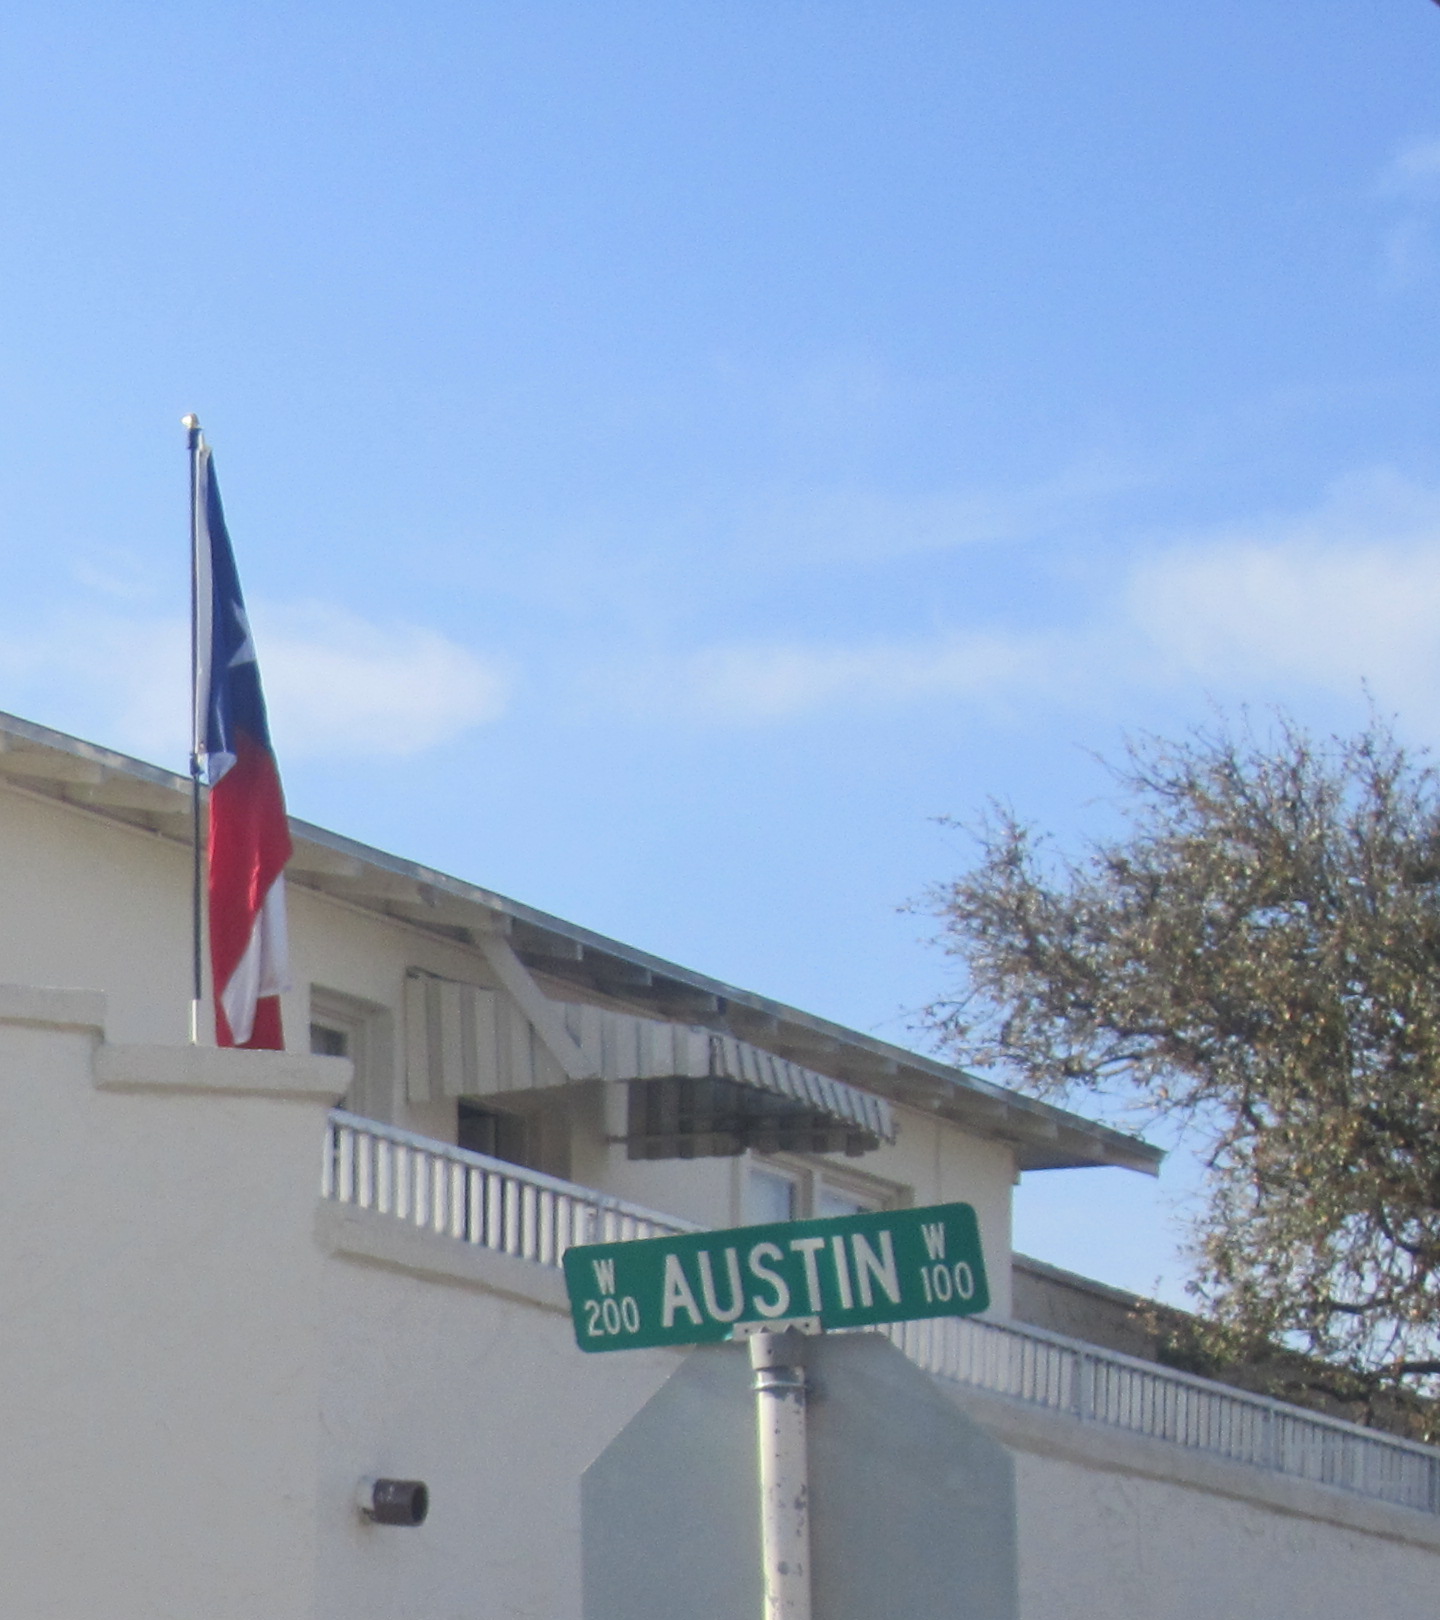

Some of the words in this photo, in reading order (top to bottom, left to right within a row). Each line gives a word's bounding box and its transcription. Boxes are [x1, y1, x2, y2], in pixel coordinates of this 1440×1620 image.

[919, 1221, 947, 1260] W
[591, 1258, 616, 1296] W
[660, 1230, 902, 1328] AUSTIN
[920, 1260, 975, 1303] 100
[583, 1296, 641, 1337] 200
